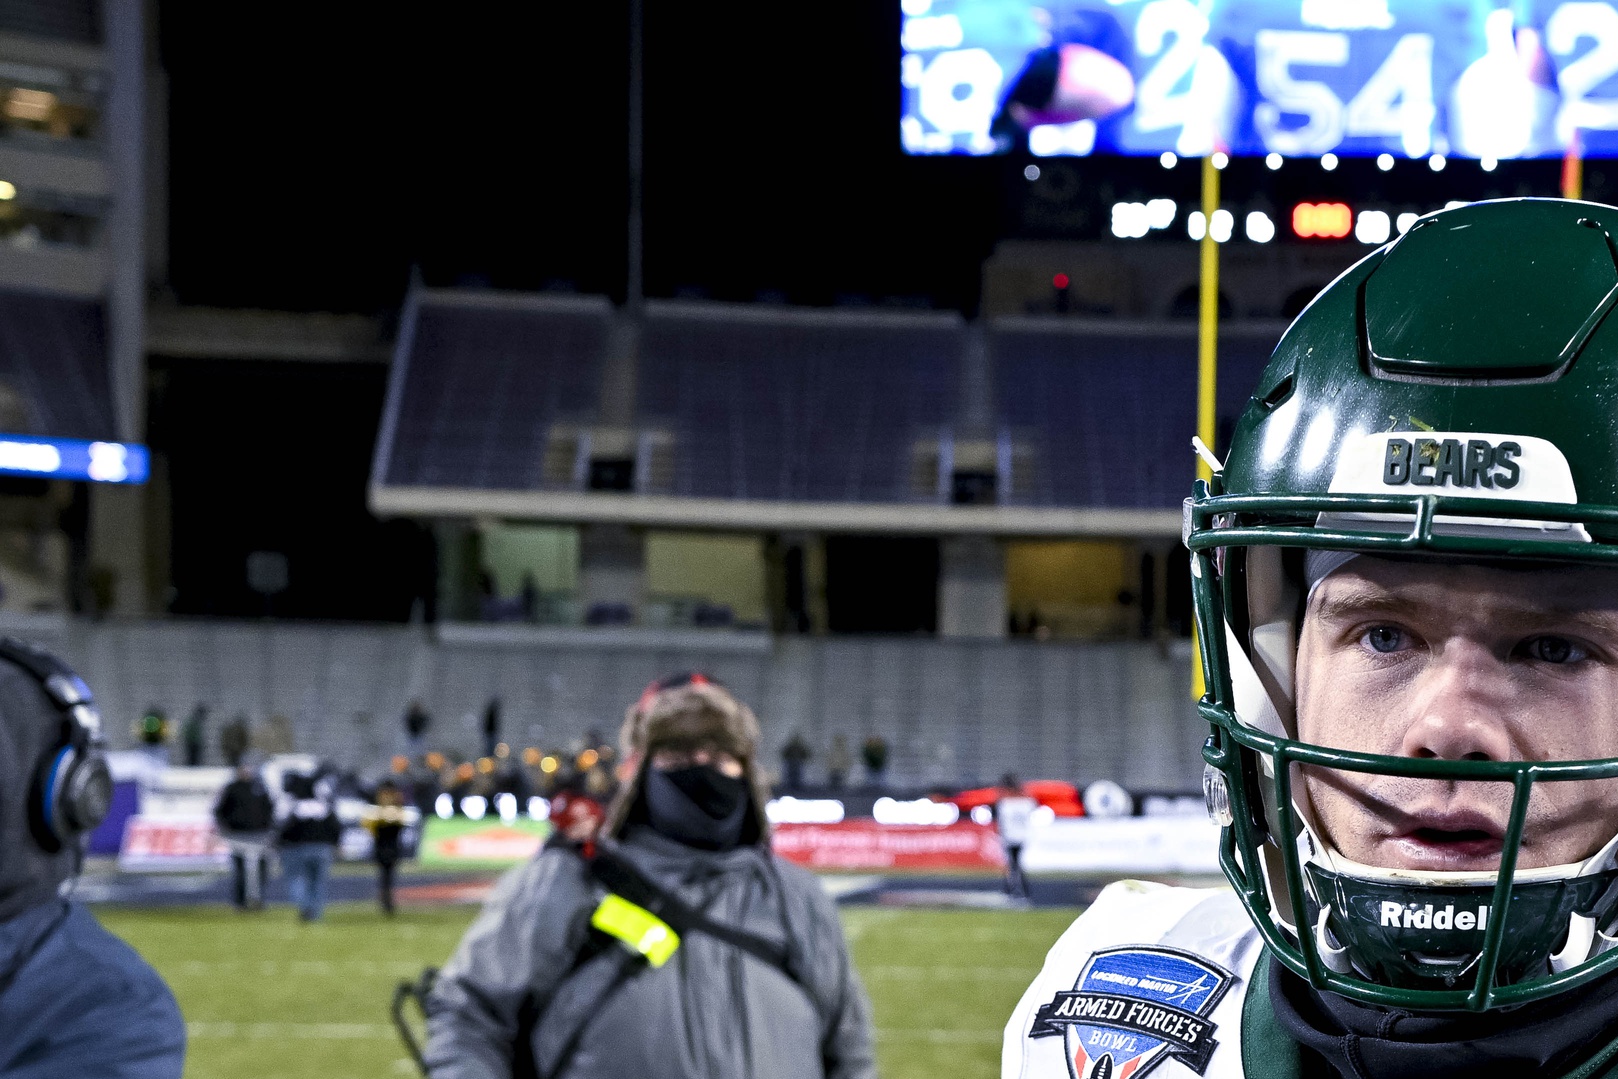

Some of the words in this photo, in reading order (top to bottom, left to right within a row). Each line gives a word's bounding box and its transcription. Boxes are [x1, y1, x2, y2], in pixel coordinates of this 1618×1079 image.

[1255, 30, 1434, 155] 54
[1383, 438, 1521, 489] BEARS
[1381, 900, 1493, 931] Riddel
[1055, 997, 1125, 1020] ARMED
[1125, 1002, 1203, 1044] FORCES
[1088, 1030, 1137, 1052] BOWL
